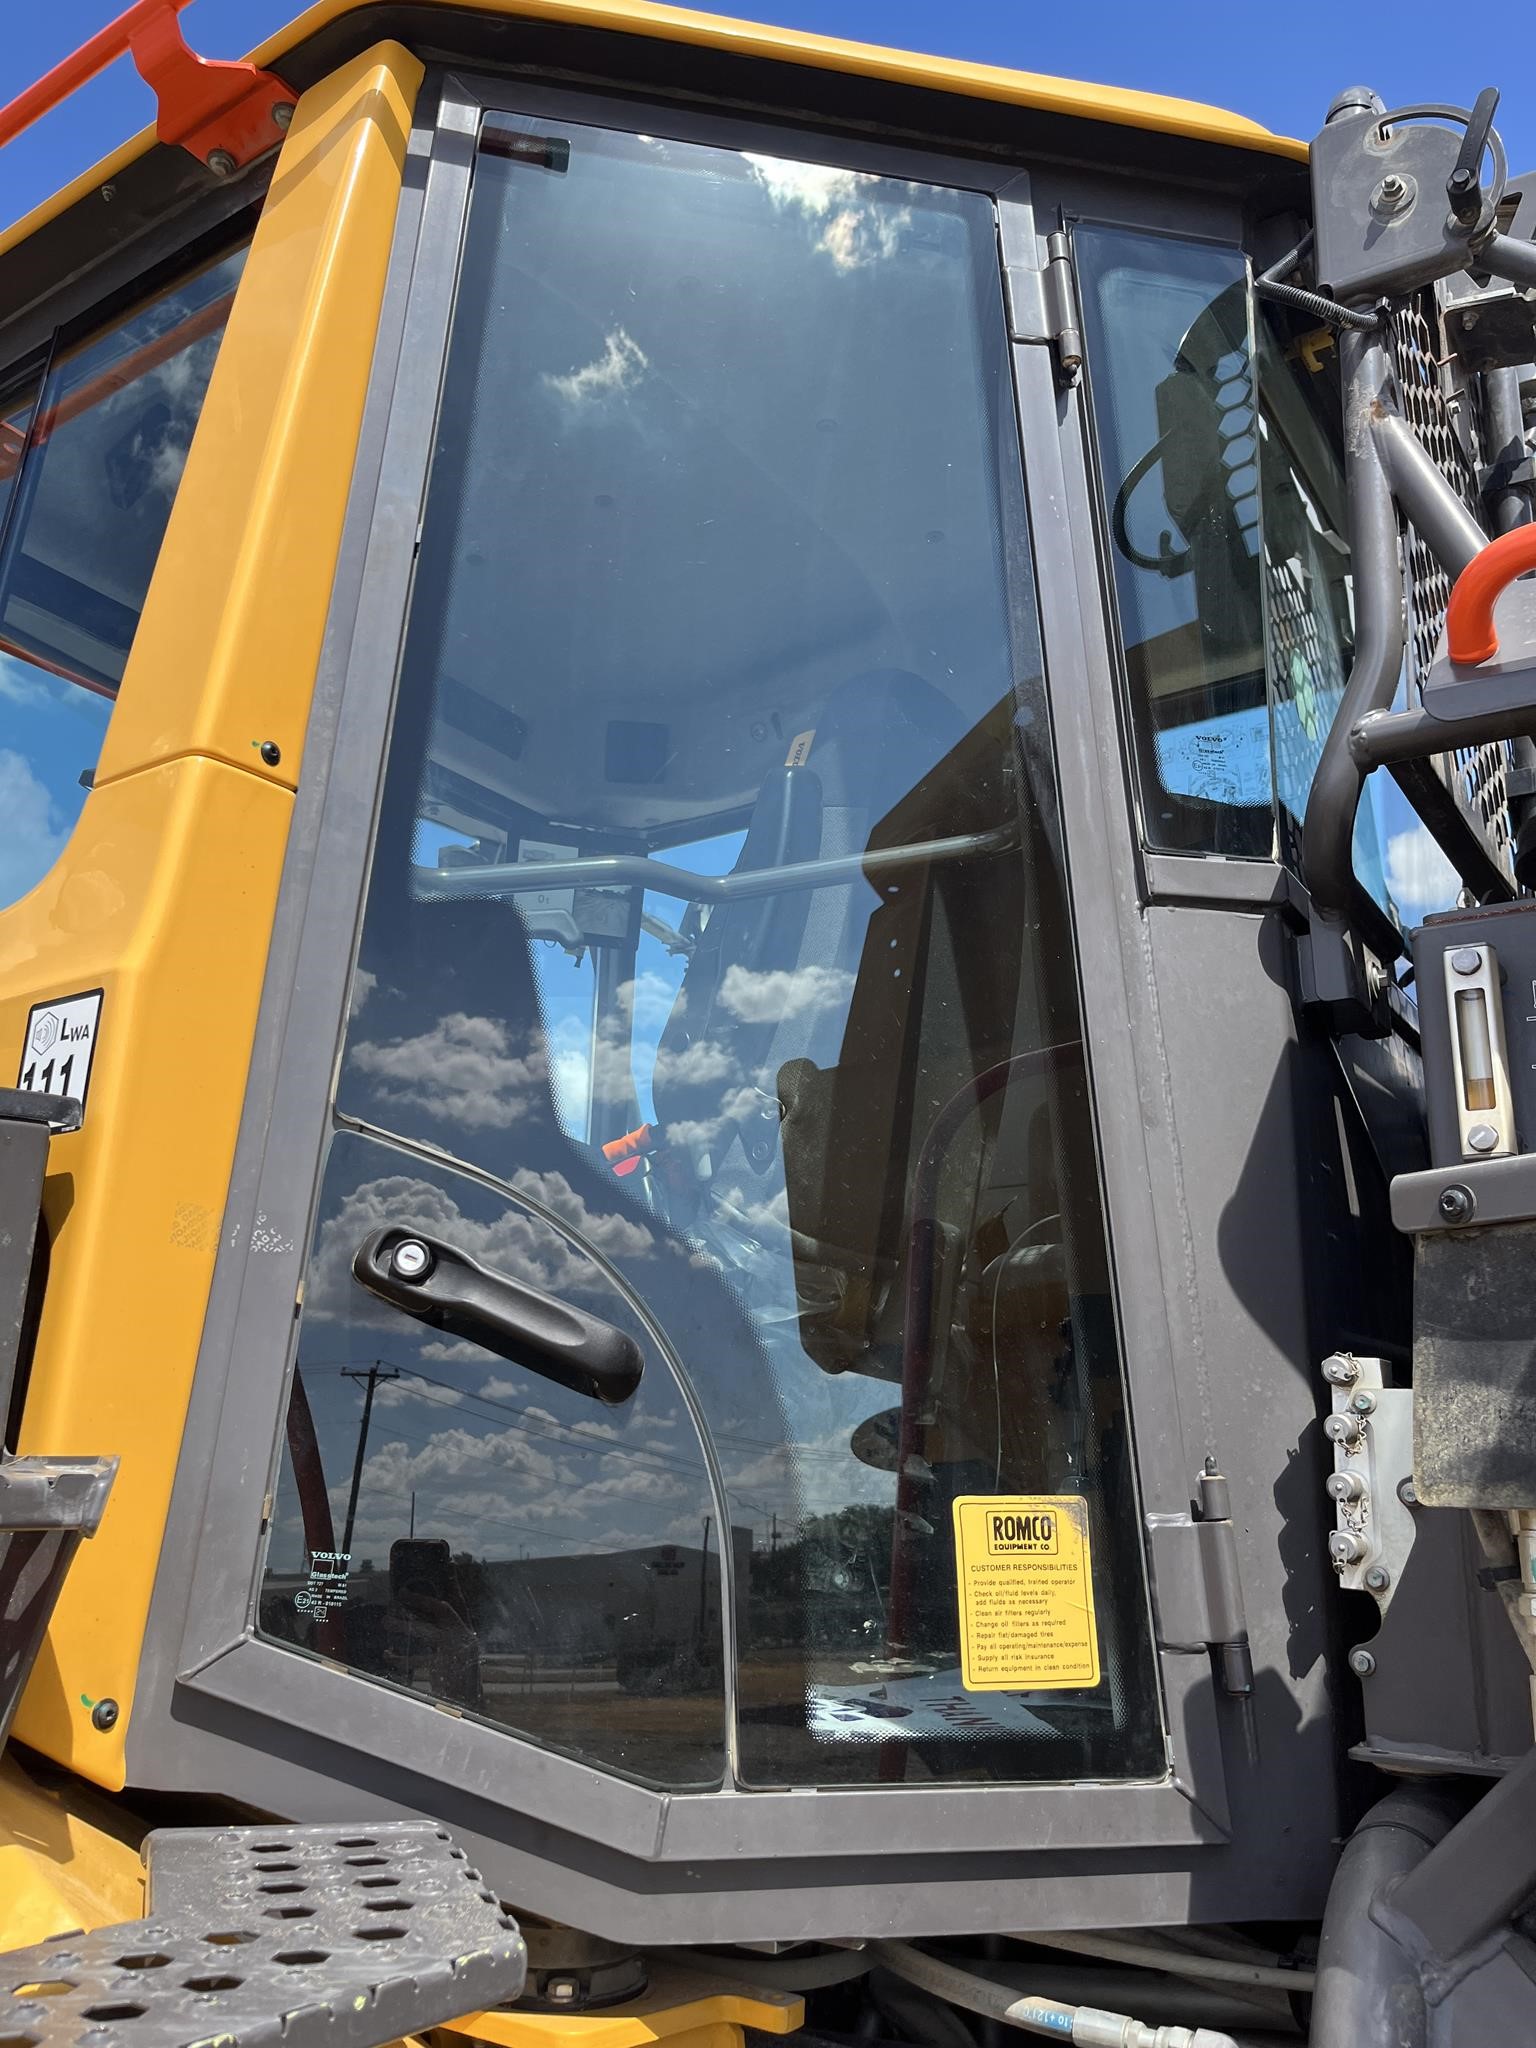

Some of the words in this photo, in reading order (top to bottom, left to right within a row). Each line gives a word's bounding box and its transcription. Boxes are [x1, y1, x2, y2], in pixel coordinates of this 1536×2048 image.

[1195, 735, 1223, 743] VOLVO
[993, 1516, 1052, 1541] ROMCO
[311, 1551, 352, 1561] VOLVO
[971, 1564, 1011, 1572] CUSTOMER
[1013, 1563, 1078, 1572] RESPONSIBILITIES
[1025, 1609, 1051, 1617] regularly
[976, 1621, 998, 1629] Change
[1041, 1619, 1066, 1627] required
[998, 1631, 1038, 1639] flat/damaged
[1000, 1665, 1033, 1673] equipment
